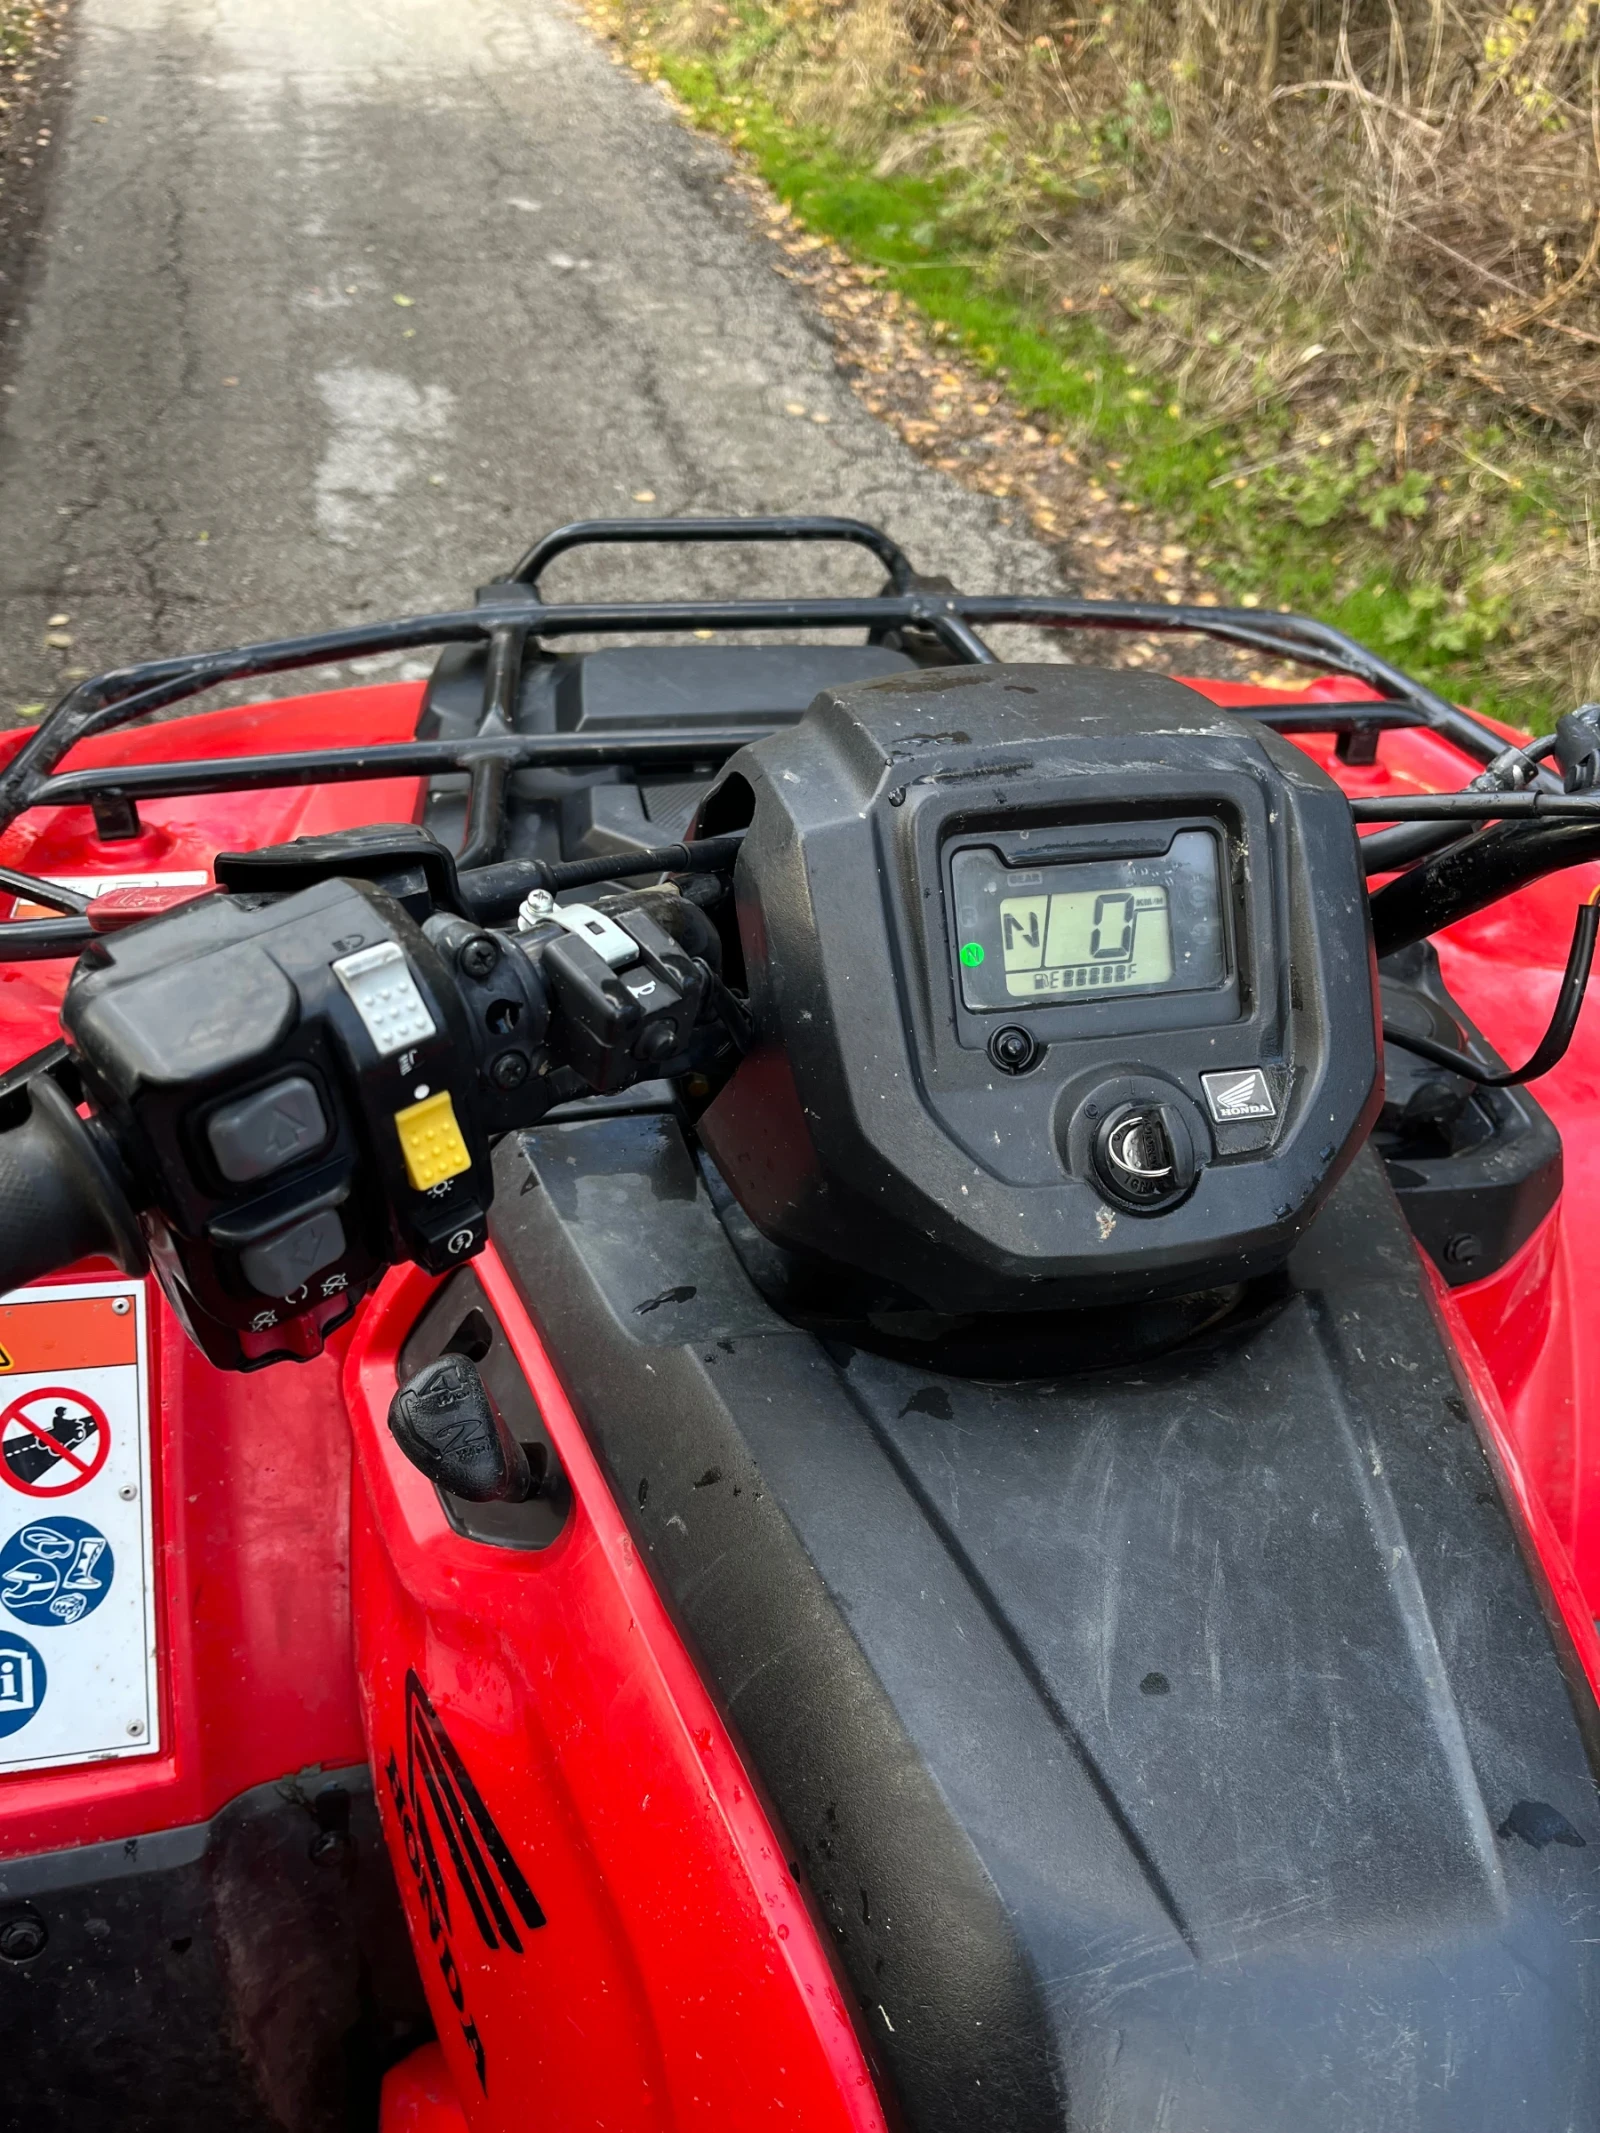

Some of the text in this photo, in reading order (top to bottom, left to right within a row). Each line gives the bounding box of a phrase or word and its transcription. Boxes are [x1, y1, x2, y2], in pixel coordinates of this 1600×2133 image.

[1010, 874, 1041, 885] GEAR
[1003, 911, 1041, 951] N
[1089, 892, 1135, 959] 0
[966, 946, 980, 963] N
[1050, 970, 1060, 989] E
[1127, 963, 1137, 980] F
[1219, 1103, 1271, 1117] HONDA
